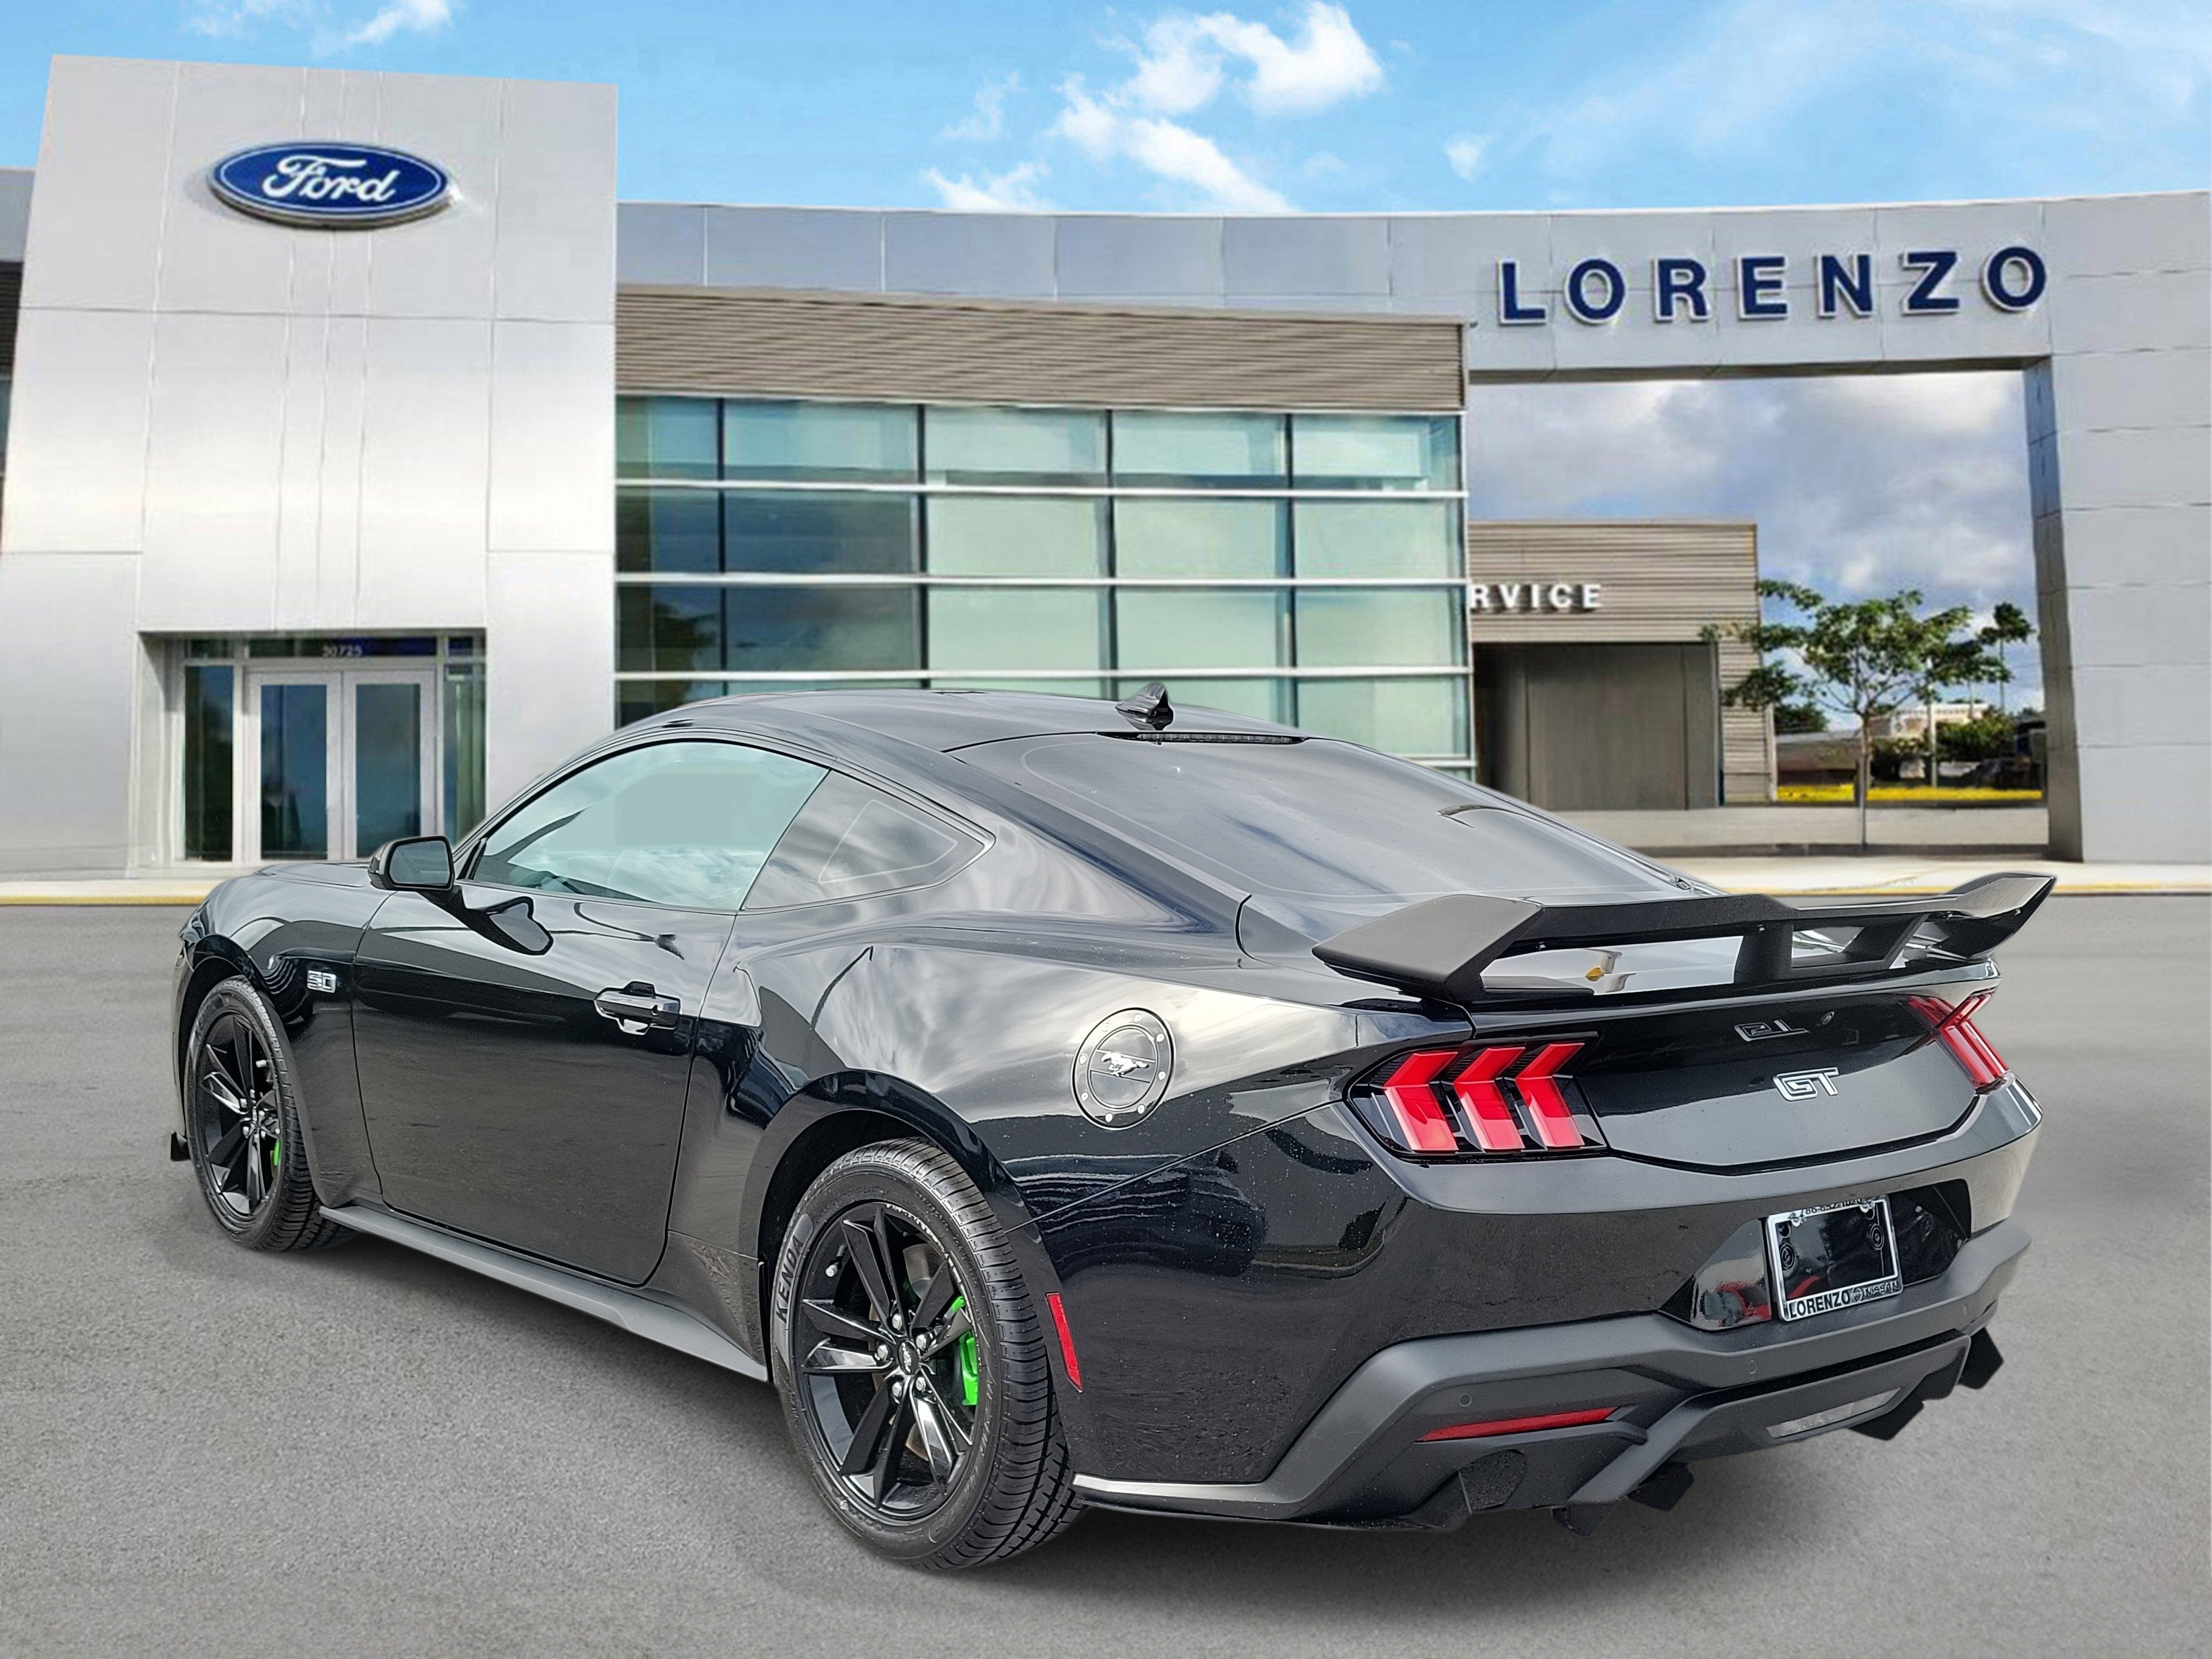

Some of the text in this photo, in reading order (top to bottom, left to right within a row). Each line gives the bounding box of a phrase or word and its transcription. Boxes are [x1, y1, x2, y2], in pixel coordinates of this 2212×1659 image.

[263, 155, 400, 202] Ford
[1497, 246, 2047, 324] LORENZO
[1469, 584, 1601, 609] RVICE
[1773, 1066, 1839, 1102] GT
[776, 1235, 804, 1324] KENDA
[1789, 1280, 1899, 1319] LORENZO NISSAN
